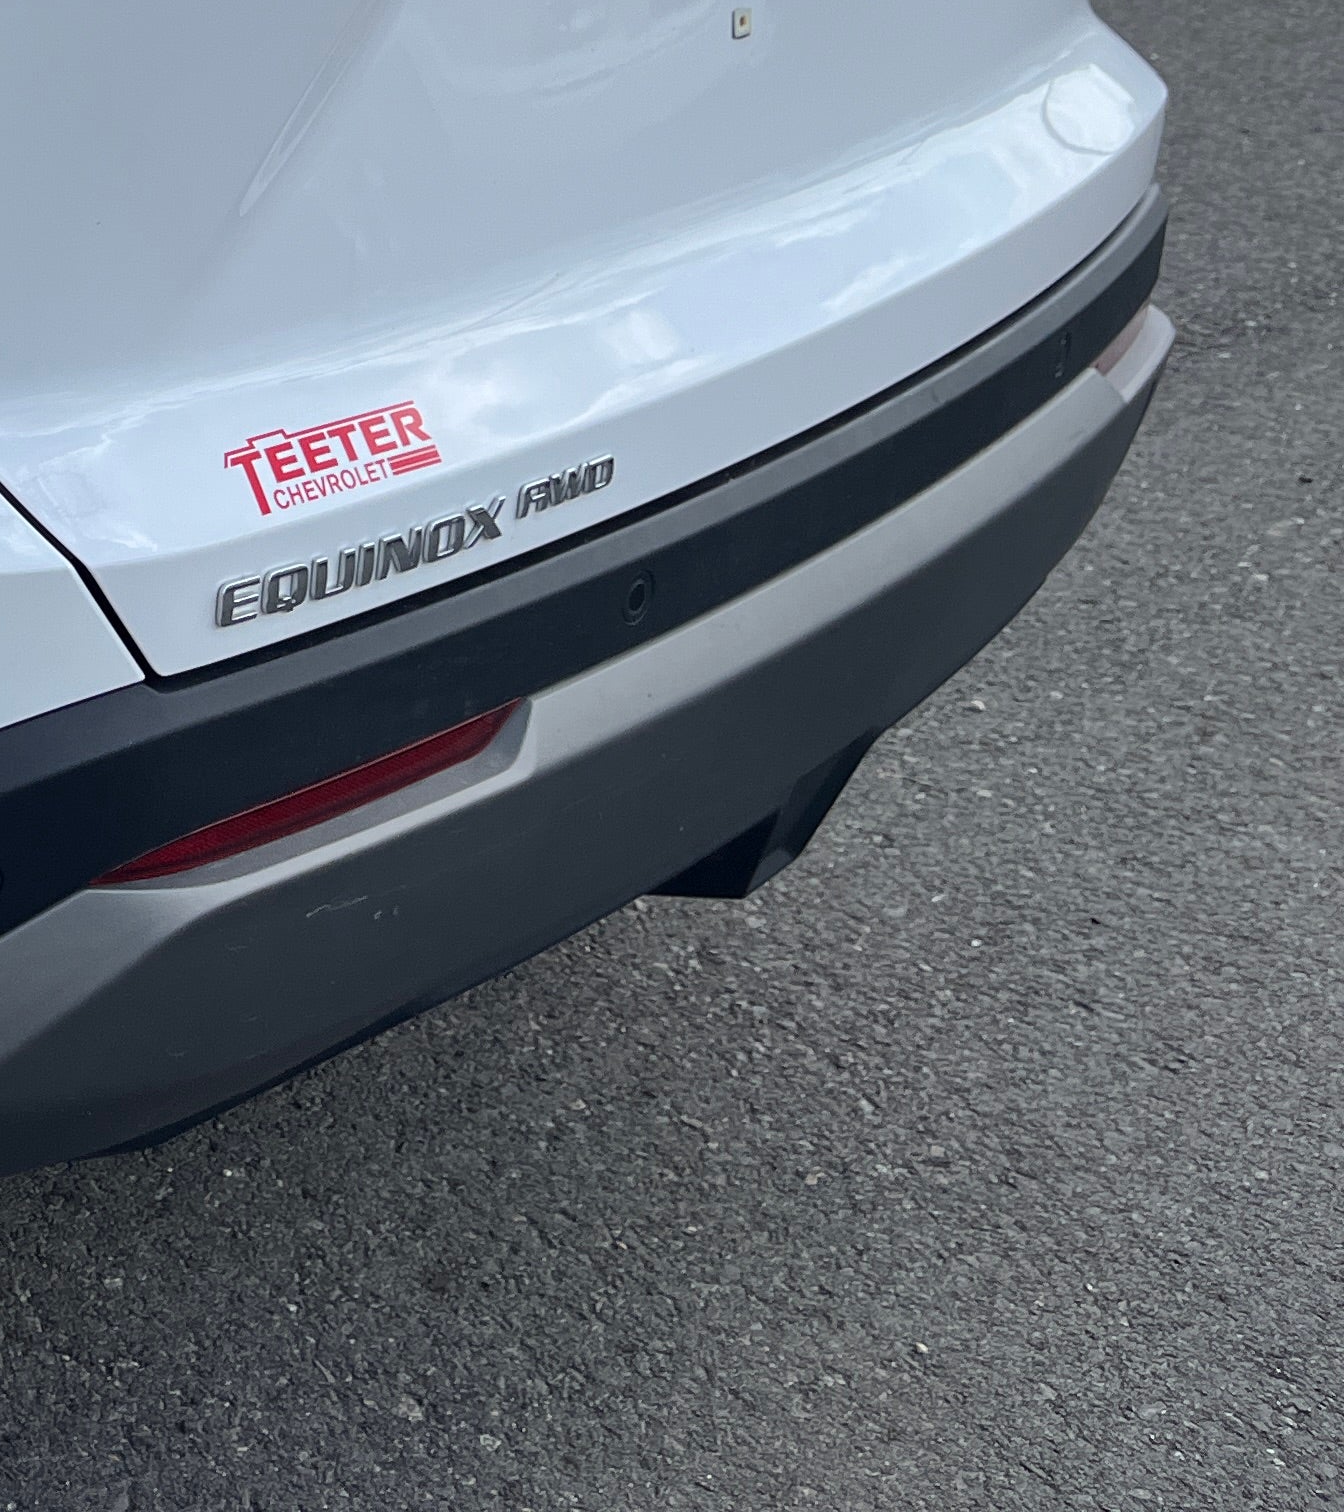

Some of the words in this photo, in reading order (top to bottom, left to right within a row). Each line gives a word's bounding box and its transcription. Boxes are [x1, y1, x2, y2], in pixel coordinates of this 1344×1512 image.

[224, 399, 433, 516] TEETER
[272, 458, 393, 510] CHEVROLET
[214, 495, 507, 628] EQUINOX
[515, 453, 616, 519] AWD
